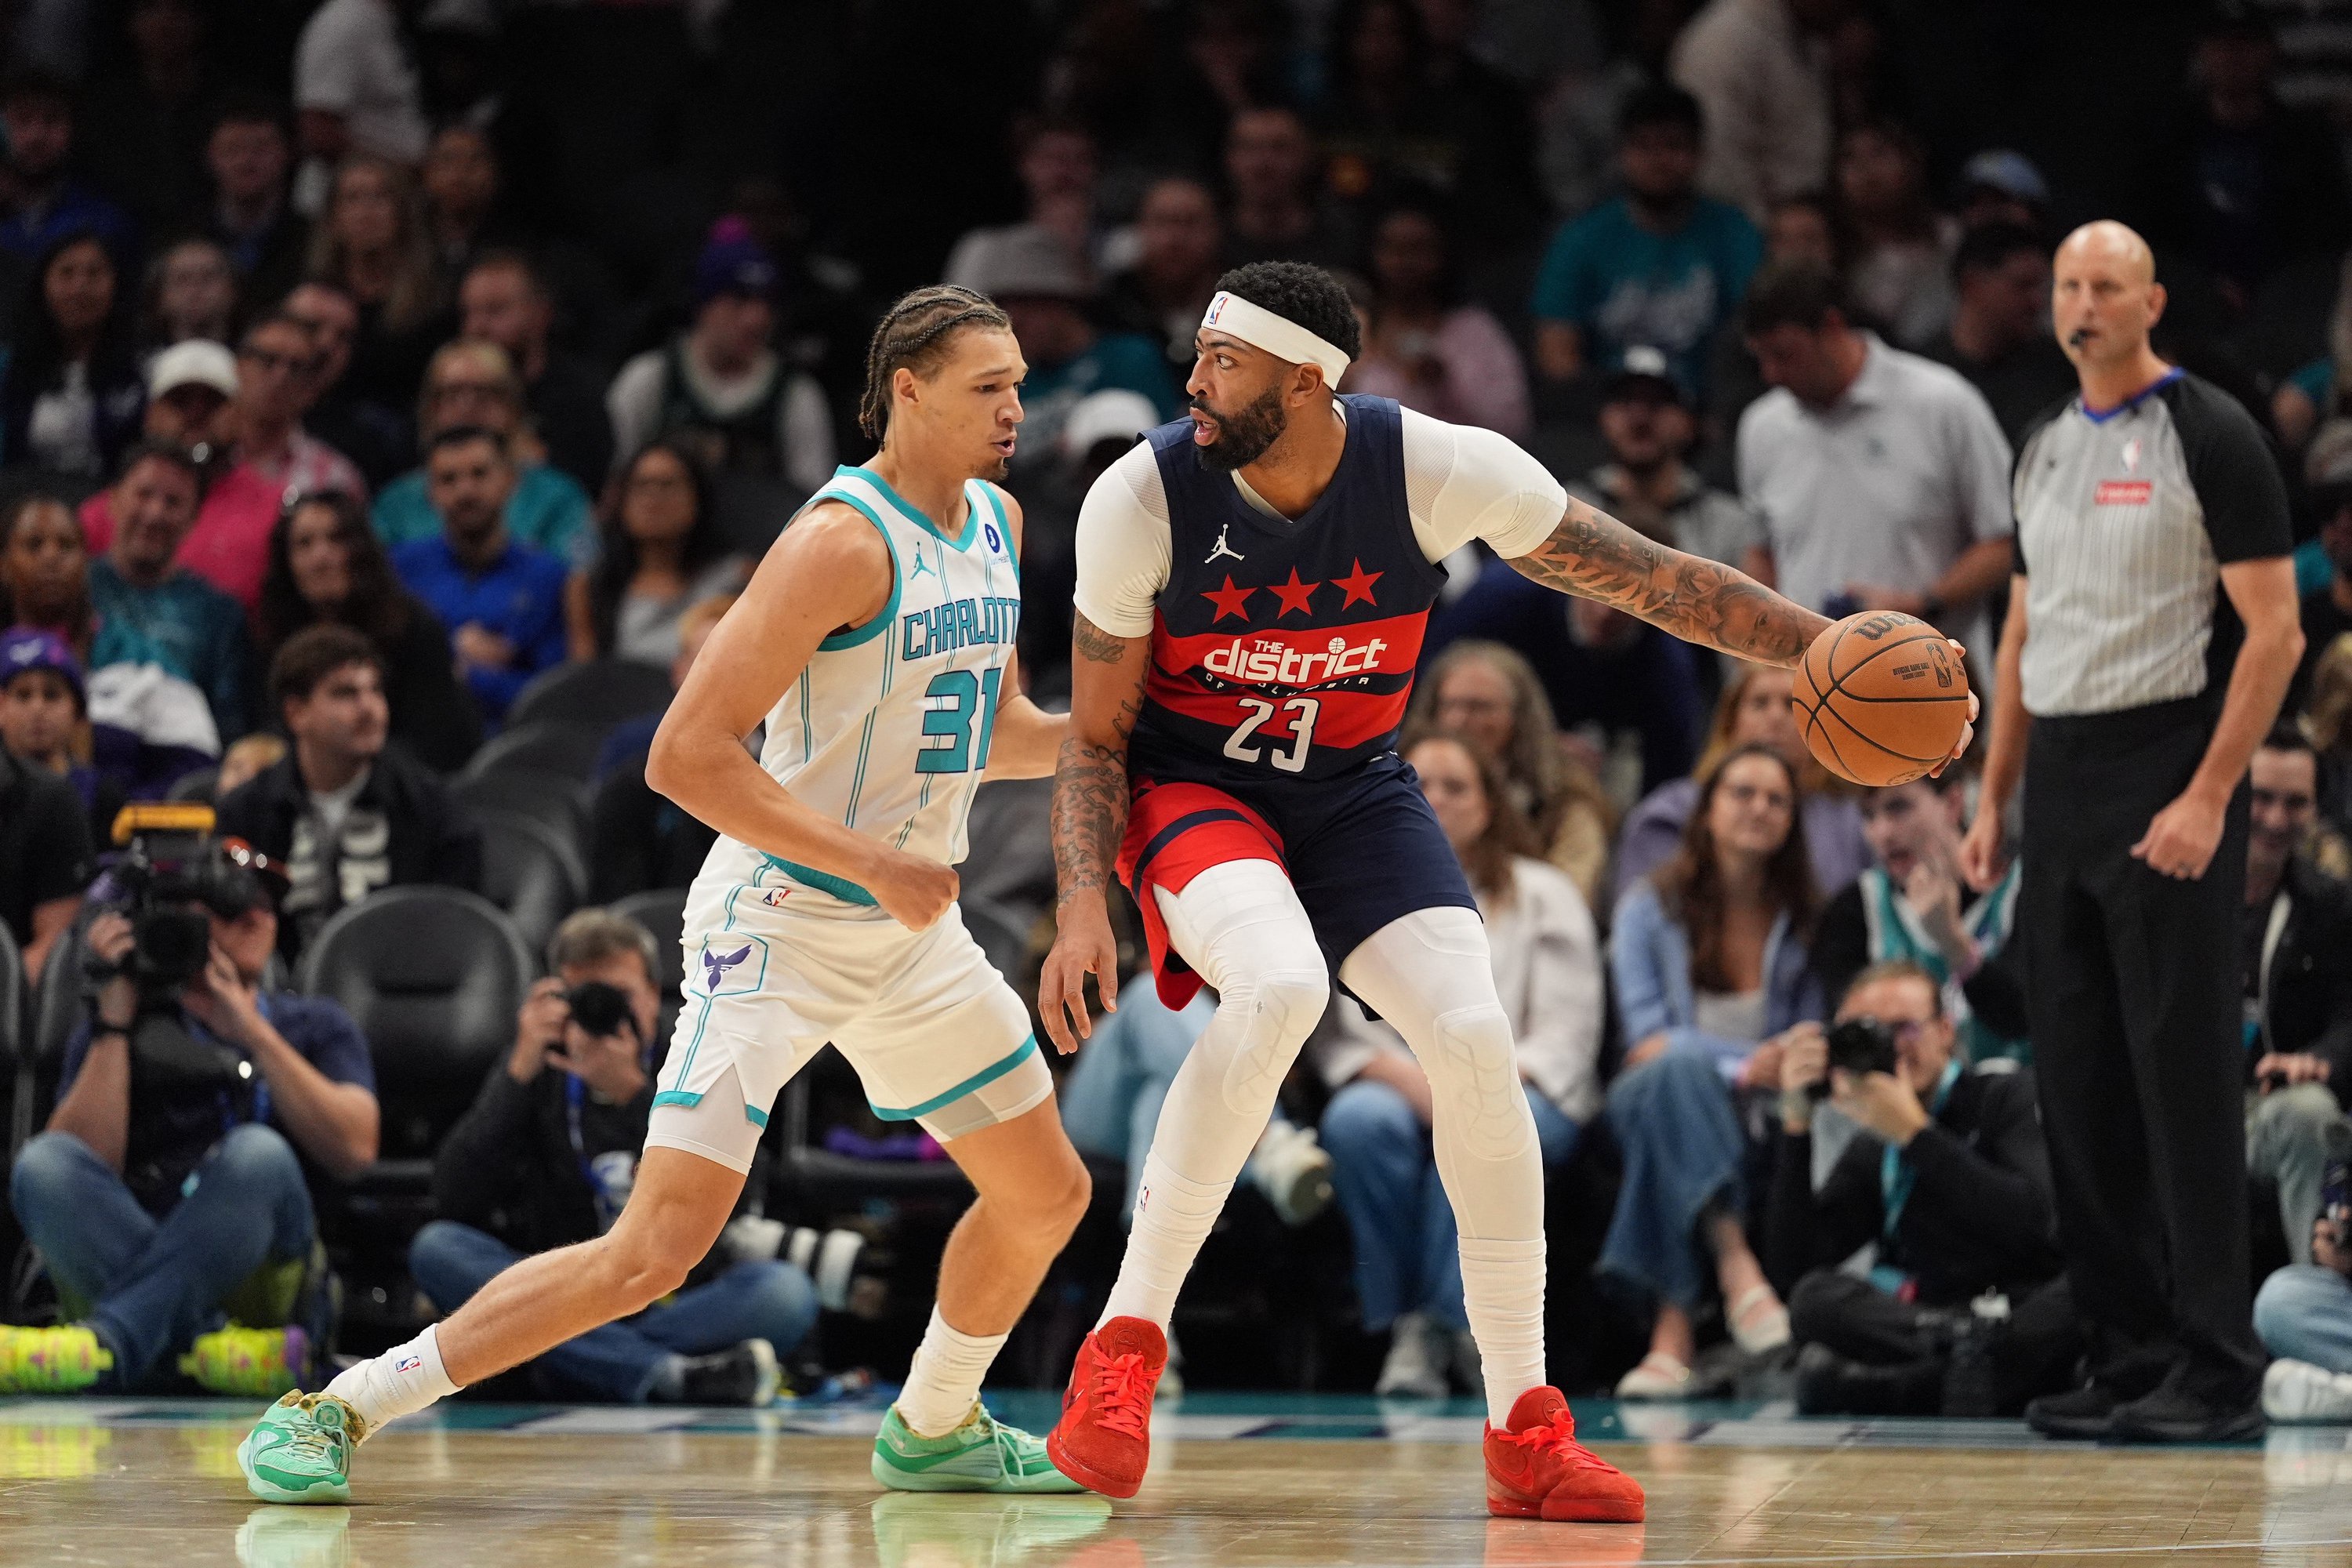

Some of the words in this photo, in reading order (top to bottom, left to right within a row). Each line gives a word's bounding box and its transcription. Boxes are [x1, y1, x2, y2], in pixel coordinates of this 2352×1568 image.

[902, 597, 1021, 661] CHARLOTT
[1254, 639, 1284, 654] THE
[1203, 637, 1388, 684] district
[1206, 673, 1225, 689] OF
[915, 667, 1002, 774] 31
[1223, 698, 1319, 773] 23
